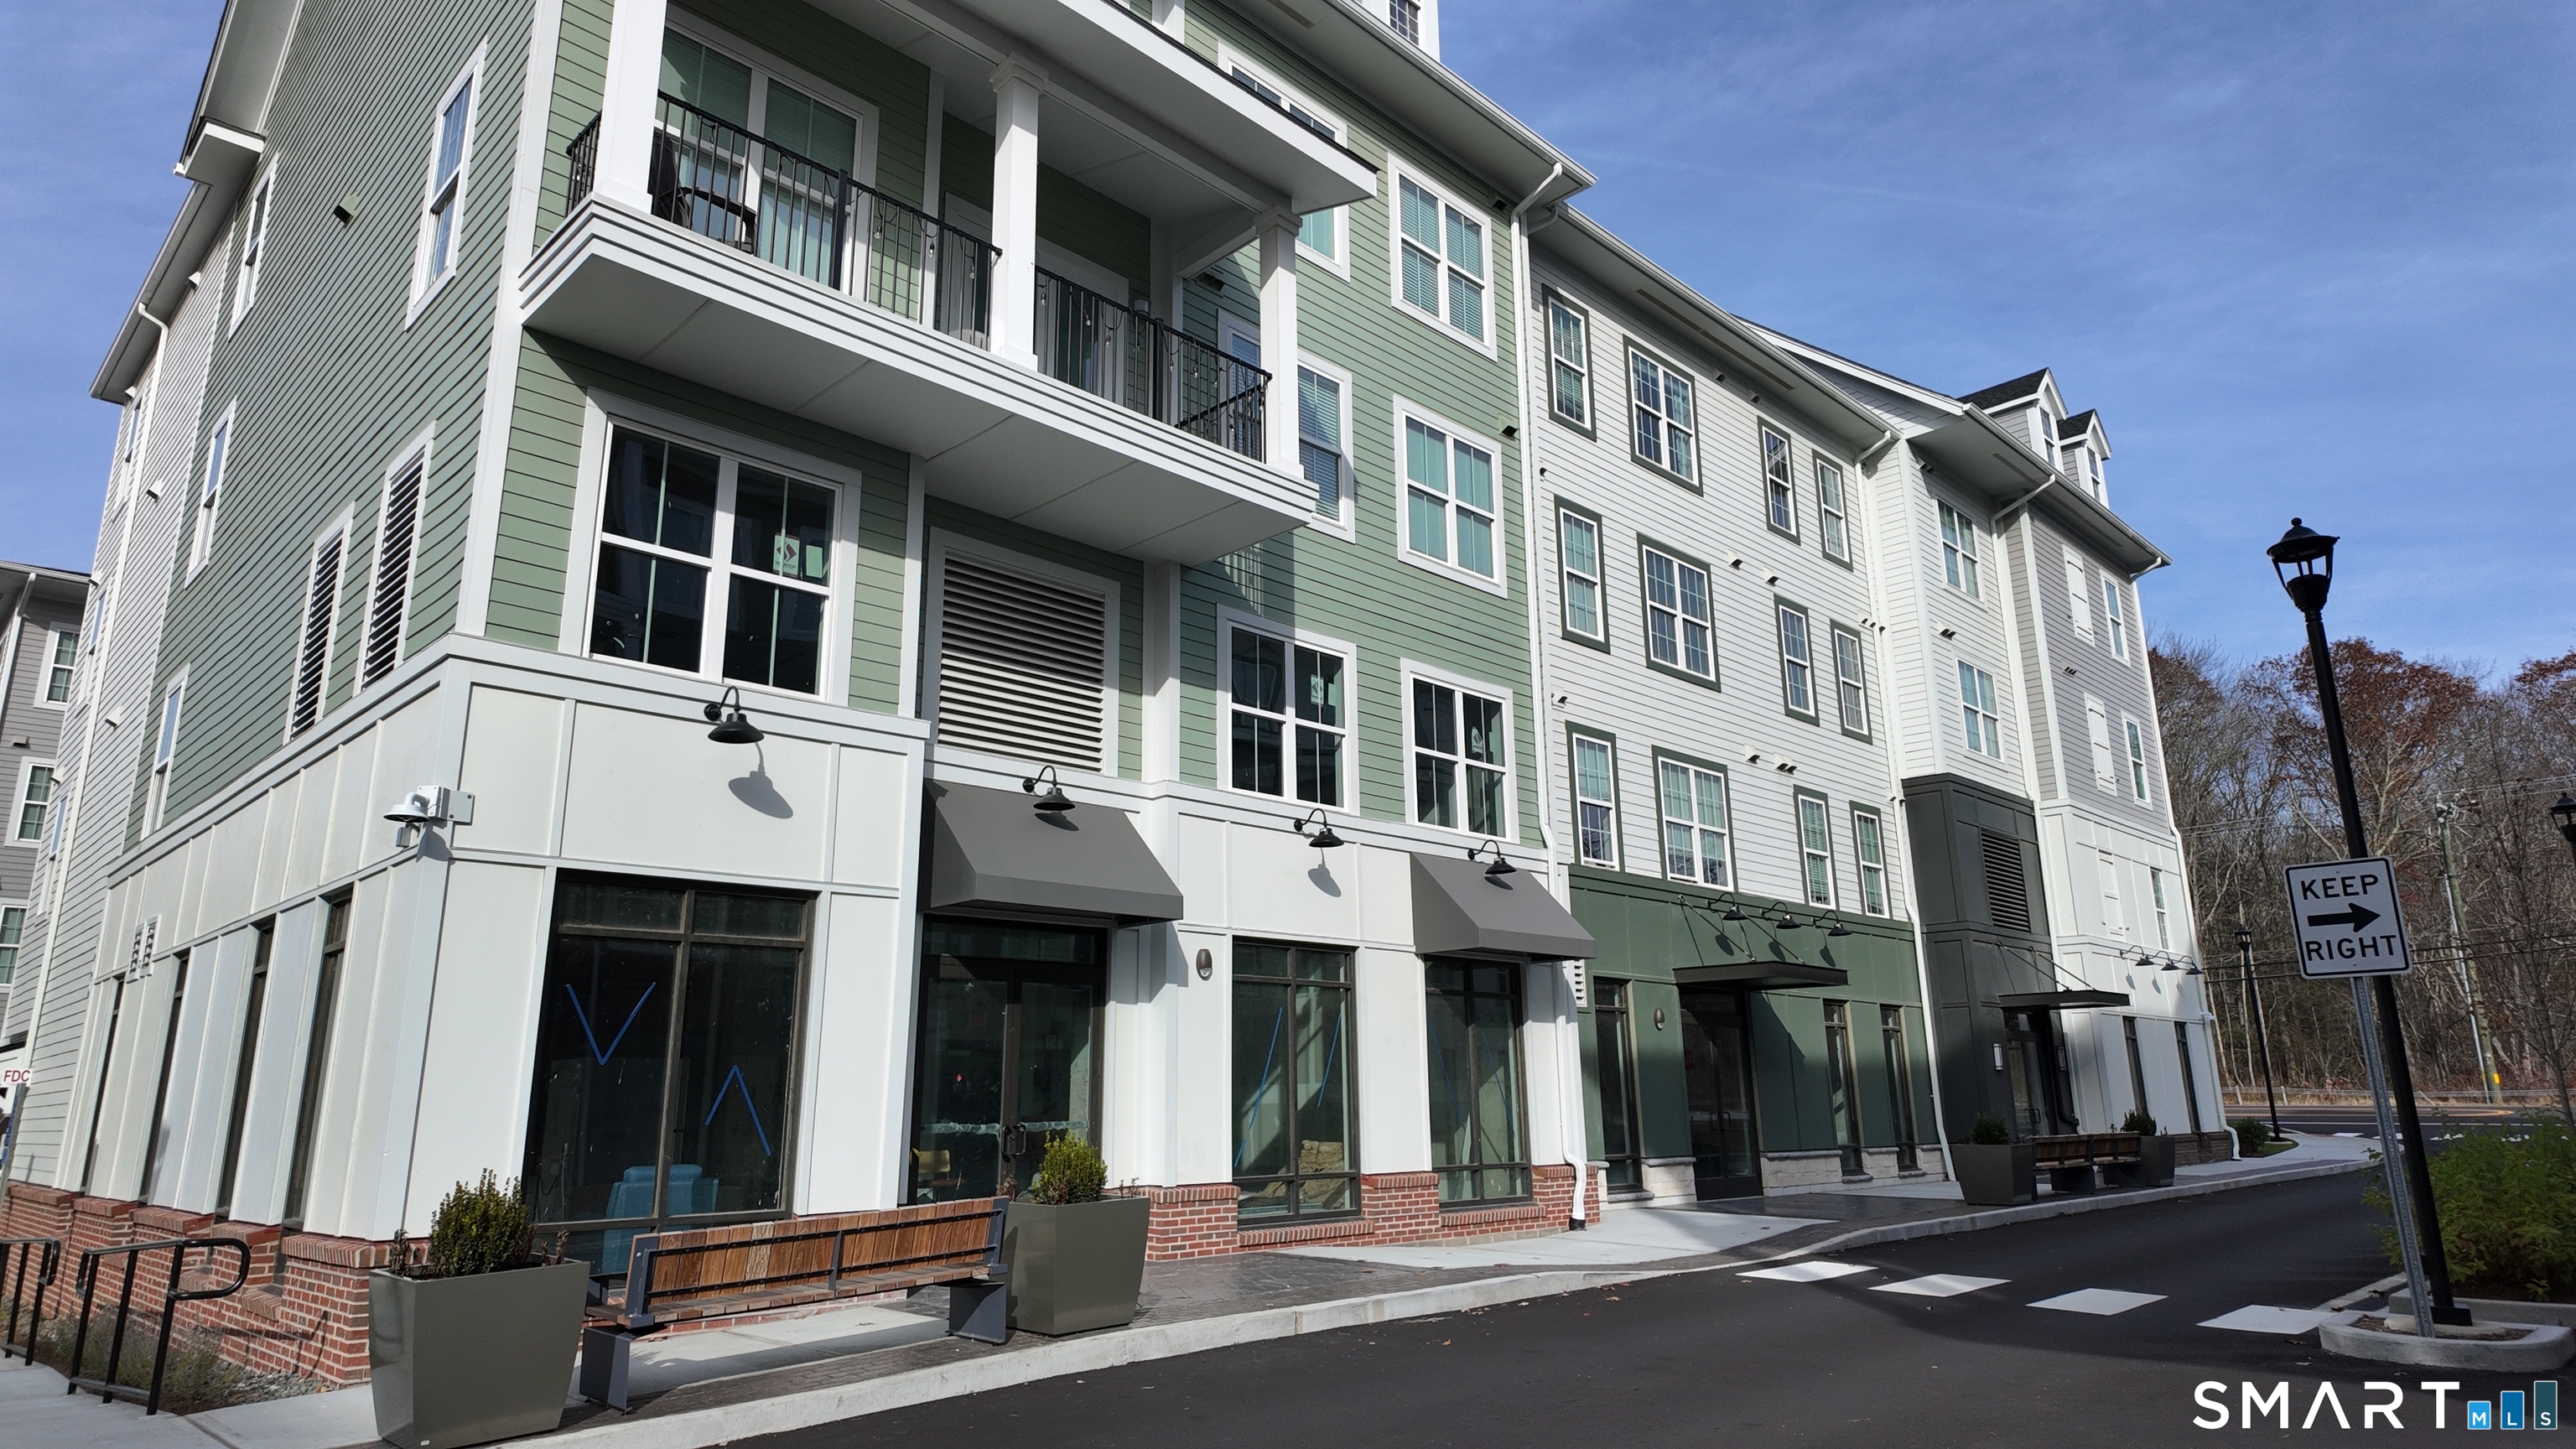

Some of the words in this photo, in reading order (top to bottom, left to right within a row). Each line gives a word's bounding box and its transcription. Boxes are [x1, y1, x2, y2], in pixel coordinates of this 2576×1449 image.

[2300, 874, 2379, 901] KEEP
[2304, 935, 2397, 962] RIGHT
[3, 1069, 30, 1082] FDC
